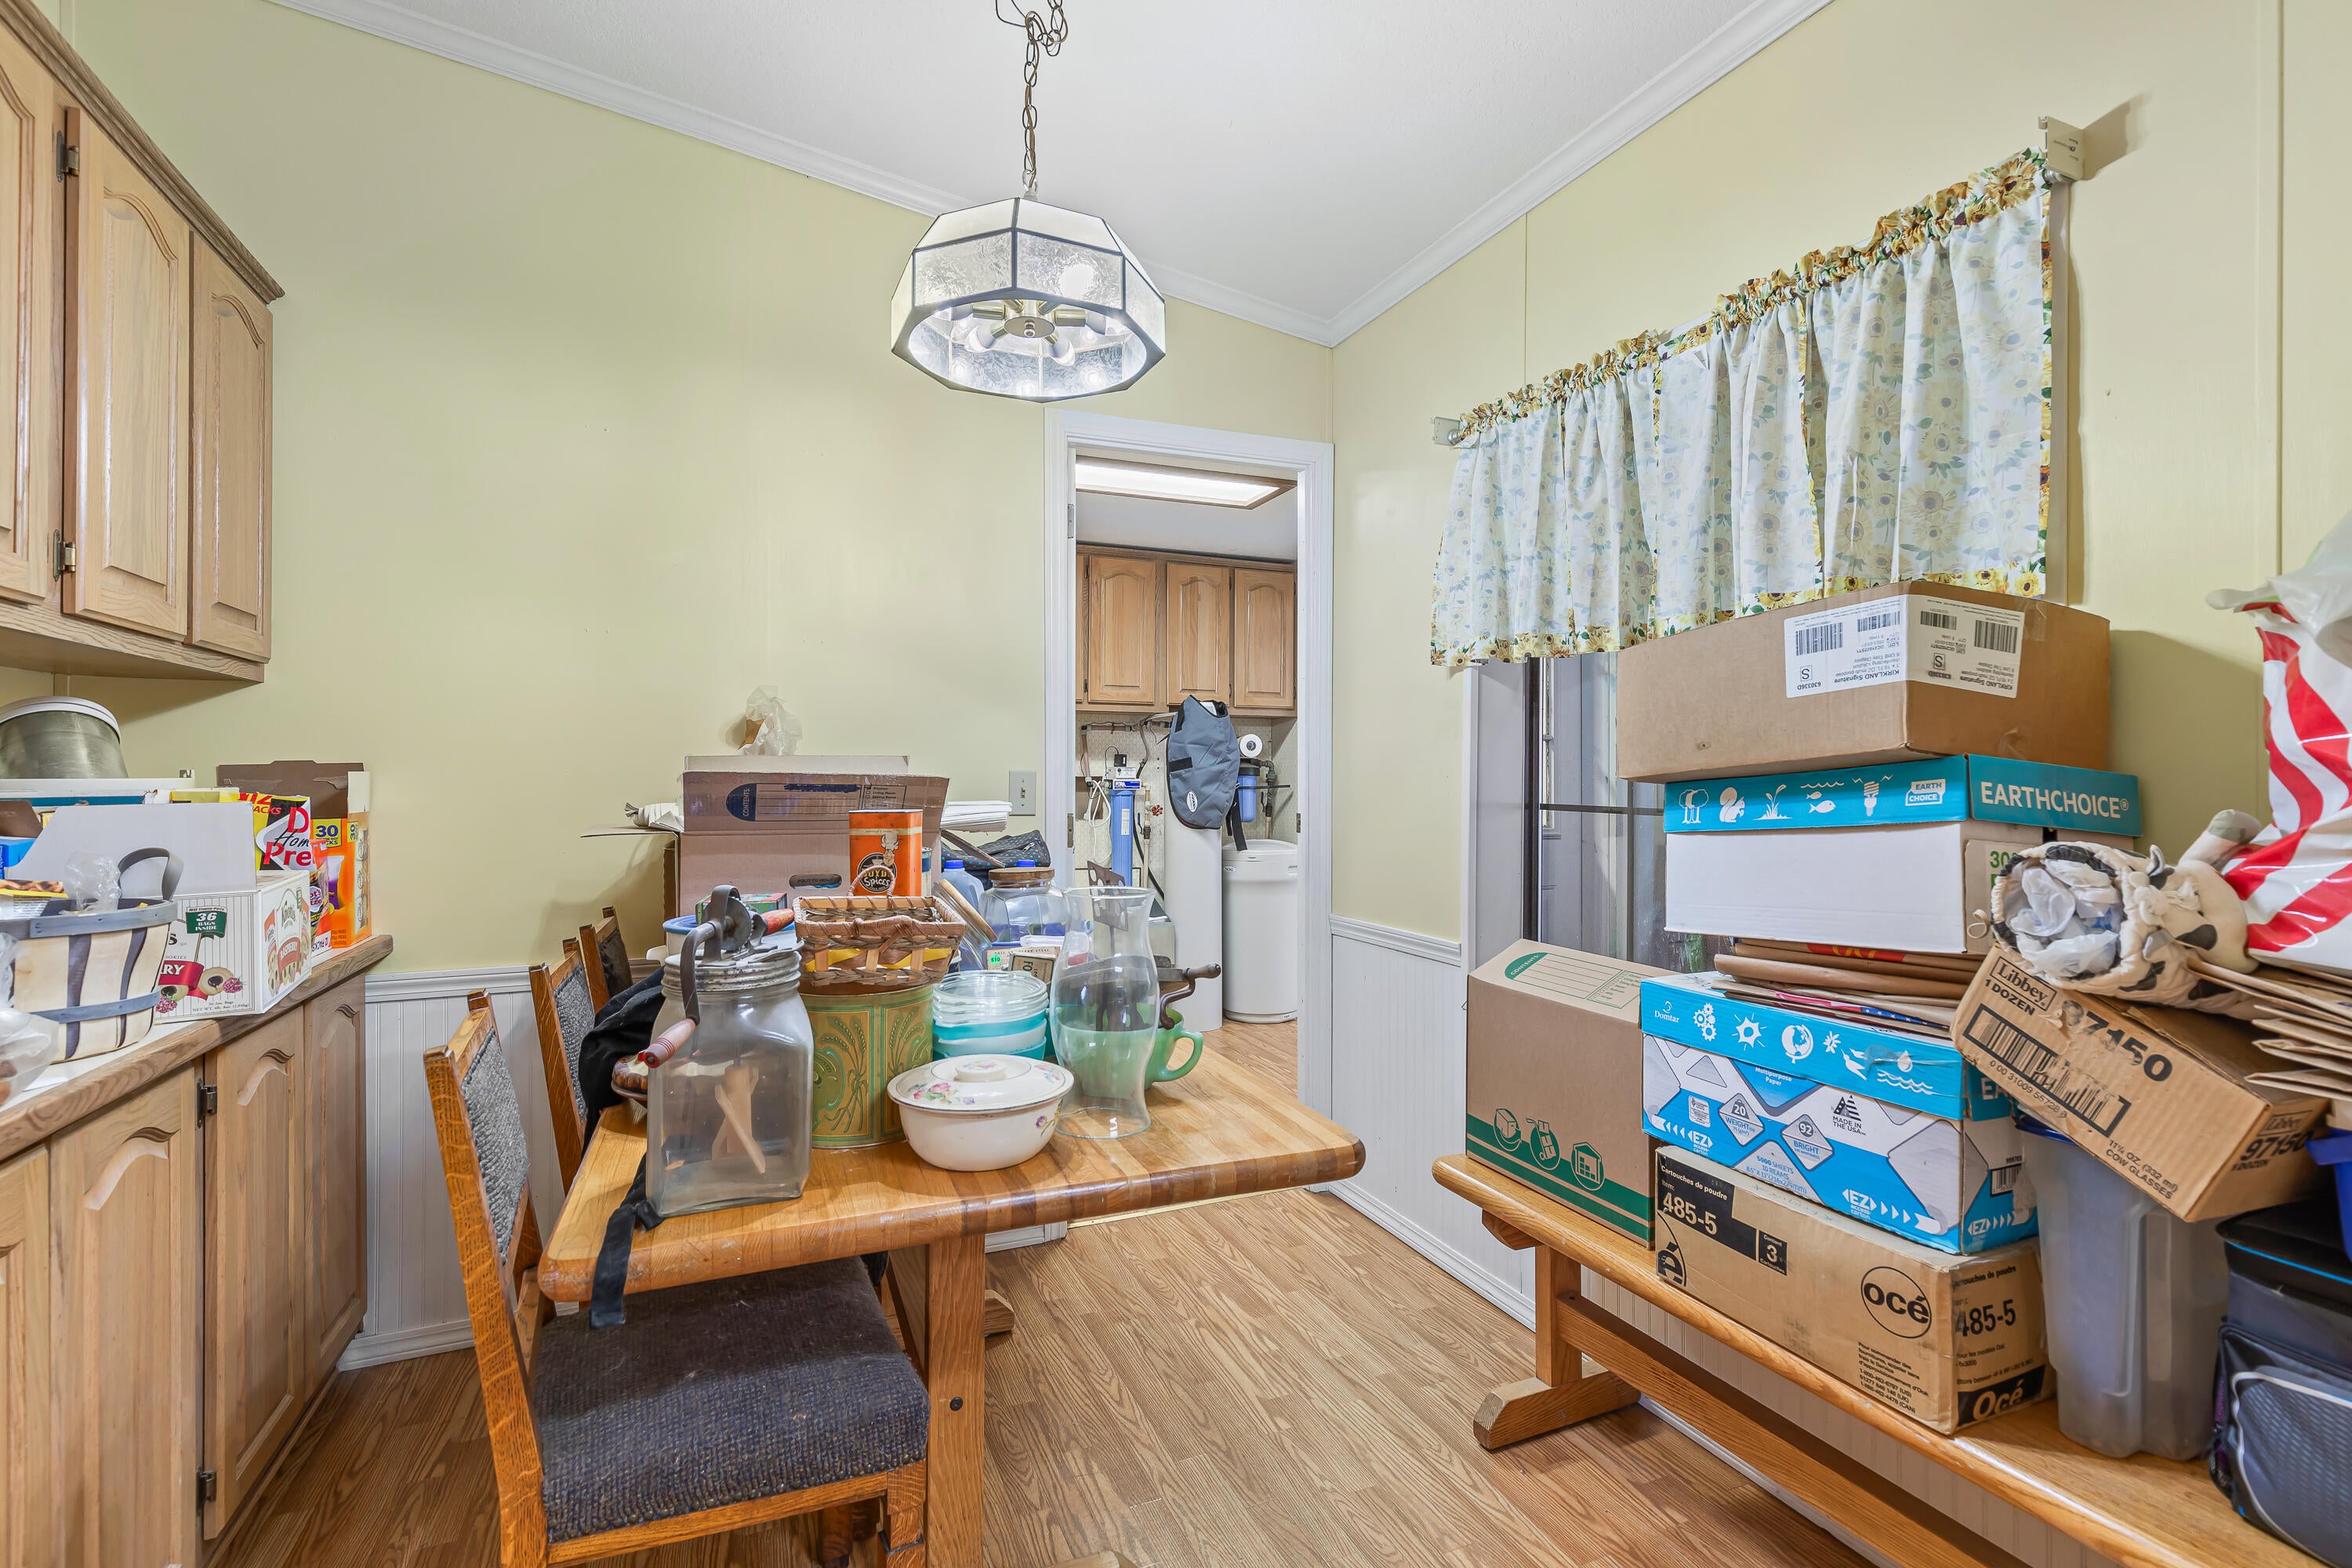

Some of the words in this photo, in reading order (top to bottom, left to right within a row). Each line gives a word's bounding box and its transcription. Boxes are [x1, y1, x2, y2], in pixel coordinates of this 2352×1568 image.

[1934, 655, 1944, 667] S
[1801, 668, 1810, 680] S
[1834, 673, 1863, 684] Signature
[1864, 669, 1900, 680] KIRKLAND
[1797, 681, 1821, 690] 630336D
[1959, 676, 1985, 686] Signature
[1986, 681, 2013, 690] KIRKLAND
[1915, 782, 1942, 790] EARTH
[1908, 793, 1938, 802] CHOICE
[252, 806, 282, 815] ACKS
[315, 825, 339, 837] 30
[350, 823, 356, 840] 30
[863, 877, 891, 887] Spices
[196, 912, 217, 922] 36
[1984, 978, 1991, 989] 1
[1991, 983, 2037, 1016] DOZEN
[1653, 1010, 1680, 1023] Domtar
[1755, 1066, 1793, 1082] Multipurpose
[1765, 1076, 1782, 1087] Paper
[2007, 1071, 2034, 1094] 31009
[1734, 1103, 1746, 1116] 20
[1725, 1116, 1750, 1131] WEIGHT
[1832, 1115, 1853, 1127] MADE
[1832, 1121, 1847, 1130] THE
[1799, 1122, 1813, 1135] 92
[1693, 1131, 1708, 1147] EZ
[1693, 1148, 1709, 1156] carton
[1793, 1140, 1820, 1155] BRIGHT
[1756, 1156, 1772, 1166] 5000
[1772, 1161, 1795, 1174] SHEETS
[1769, 1167, 1790, 1180] REAMS
[2106, 1148, 2129, 1167] COW
[2129, 1165, 2173, 1200] GLASSES
[1661, 1164, 1694, 1186] Cartouches
[1694, 1181, 1704, 1190] de
[1704, 1185, 1728, 1200] poudre
[1661, 1178, 1675, 1192] Item:
[1849, 1189, 1871, 1208] EZ
[1663, 1192, 1718, 1235] 485-5
[1850, 1208, 1871, 1221] carton
[1973, 1219, 1986, 1234] EZ
[1763, 1234, 1782, 1247] Contient
[1766, 1244, 1777, 1263] 3
[1987, 1270, 1995, 1279] de
[1996, 1265, 2016, 1279] poudre
[1864, 1282, 1929, 1324] océ
[1955, 1298, 2016, 1337] 485-5
[1858, 1341, 1870, 1351] Pour
[1871, 1347, 1902, 1366] commander
[1957, 1377, 1973, 1386] Store
[1973, 1377, 2025, 1421] Océ
[1899, 1399, 1917, 1414] (CAN)
